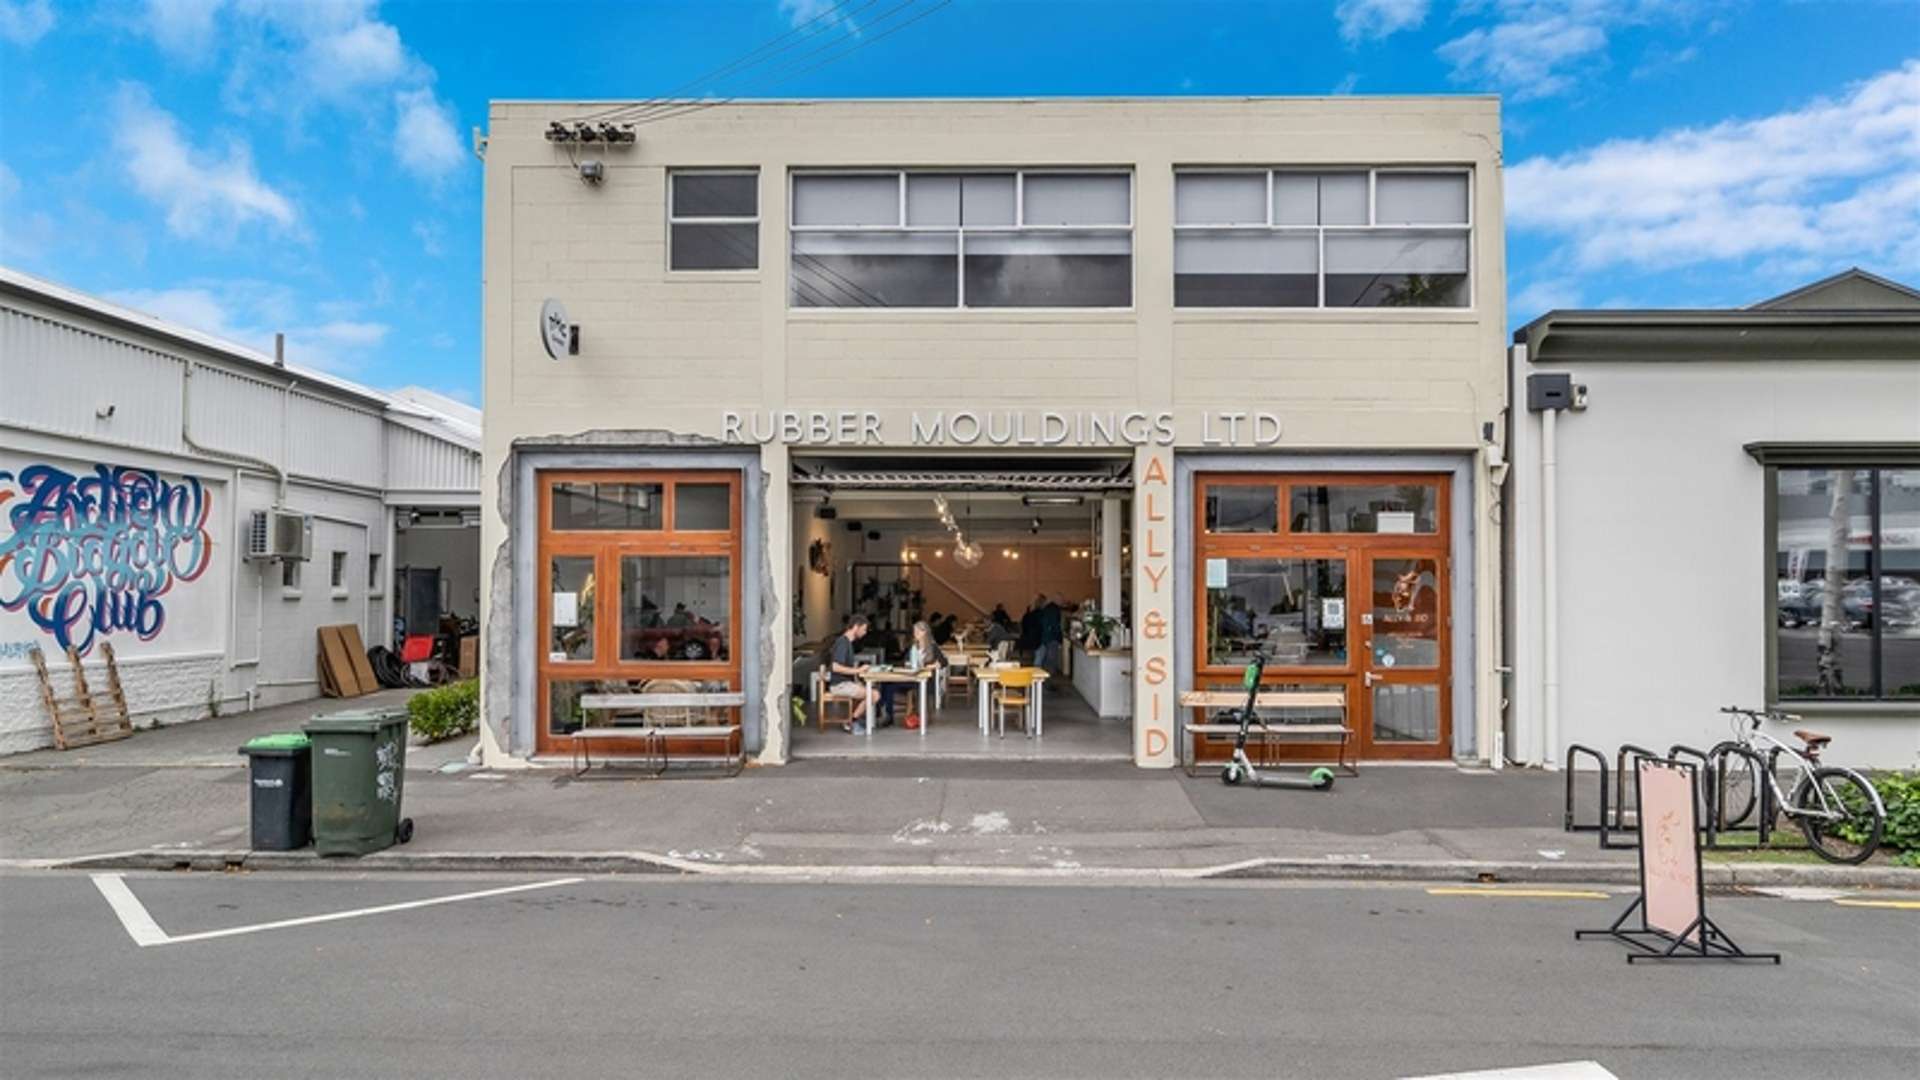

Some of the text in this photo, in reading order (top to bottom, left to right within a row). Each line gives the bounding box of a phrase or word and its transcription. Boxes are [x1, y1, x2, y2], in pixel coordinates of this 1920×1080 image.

[721, 411, 1282, 445] RUBBER MOULDINGS LTD
[28, 579, 165, 657] Club
[1142, 456, 1169, 758] ALLY & SID
